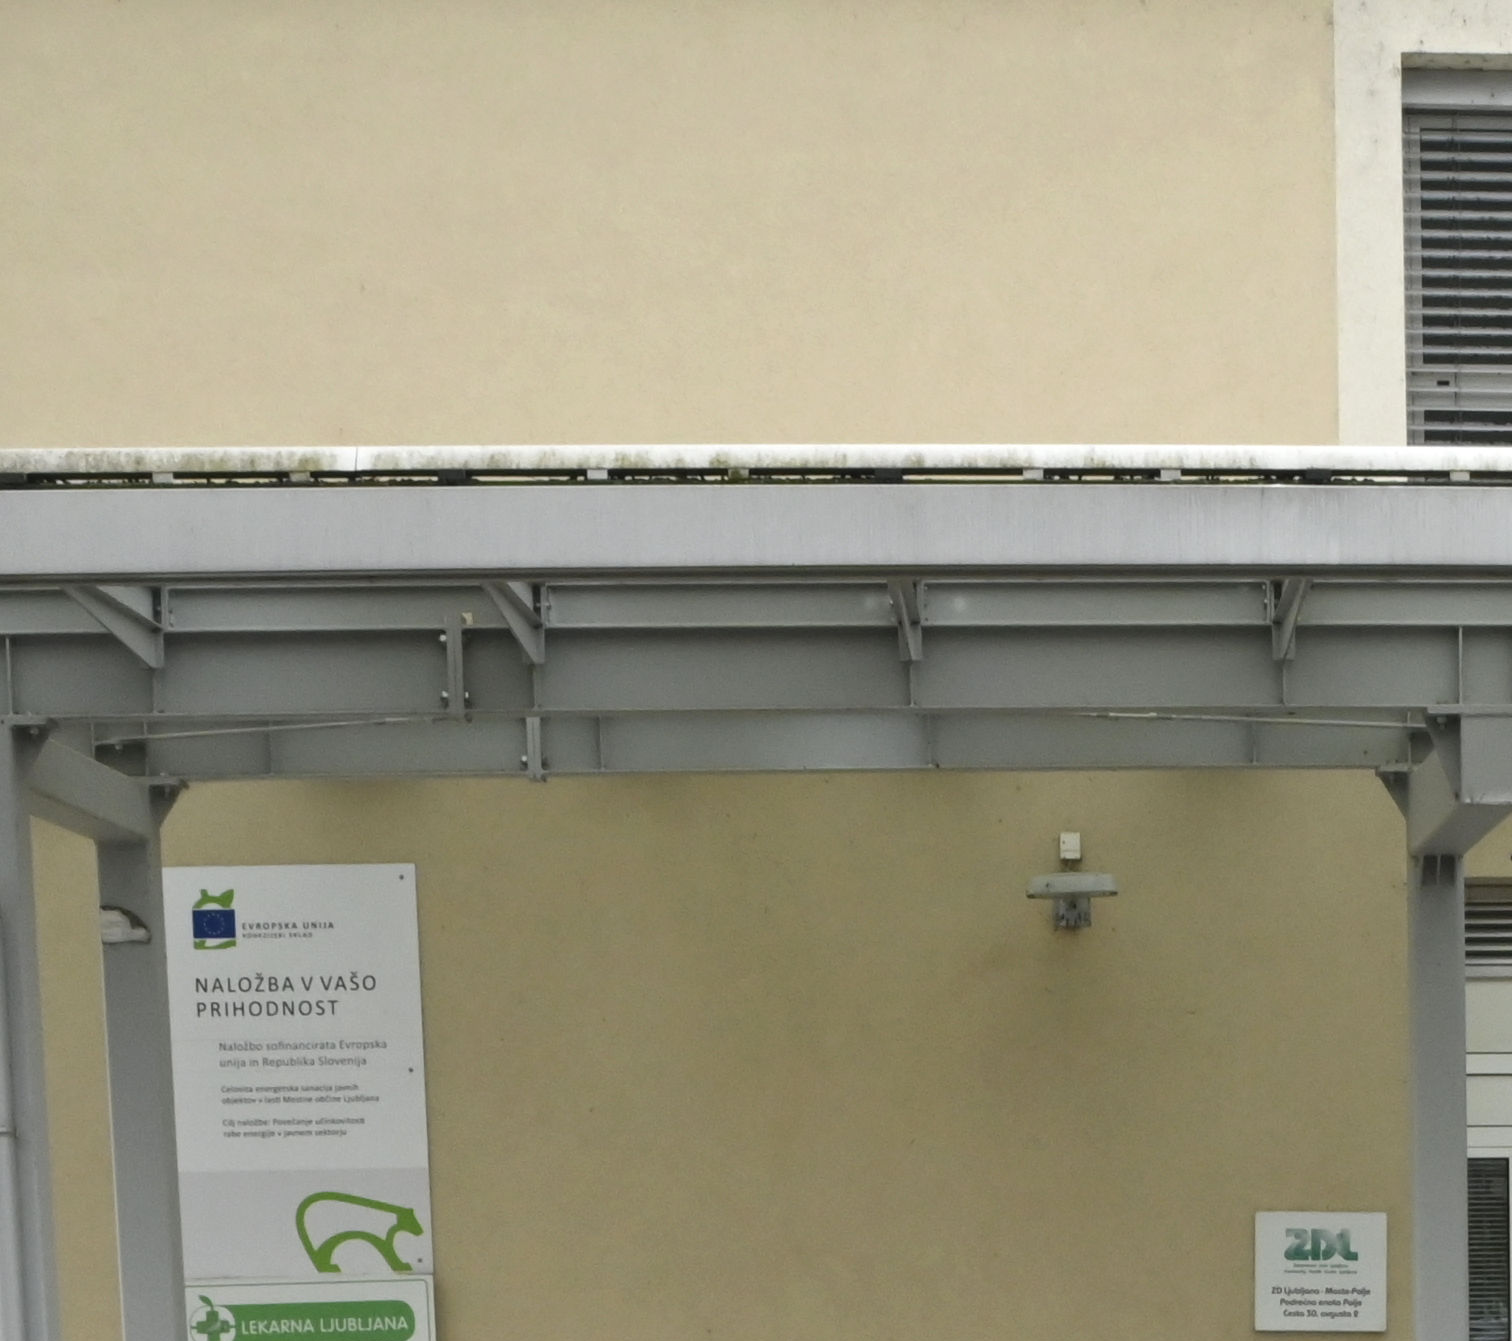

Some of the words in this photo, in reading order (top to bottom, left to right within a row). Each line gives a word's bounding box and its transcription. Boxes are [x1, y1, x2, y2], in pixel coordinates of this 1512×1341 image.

[242, 922, 298, 930] EVROPSKA
[302, 921, 334, 929] UNIJA
[195, 972, 294, 993] NALOŽBA
[301, 977, 314, 992] V
[320, 971, 377, 992] VAŠO
[196, 1000, 339, 1018] PRIHODNOST
[339, 1040, 388, 1051] Evropska
[262, 1056, 315, 1068] Republika
[318, 1056, 367, 1068] Slovenija
[1284, 1228, 1358, 1261] ZDL
[241, 1318, 314, 1335] LEKARNA
[320, 1315, 408, 1333] LJUBLJANA
